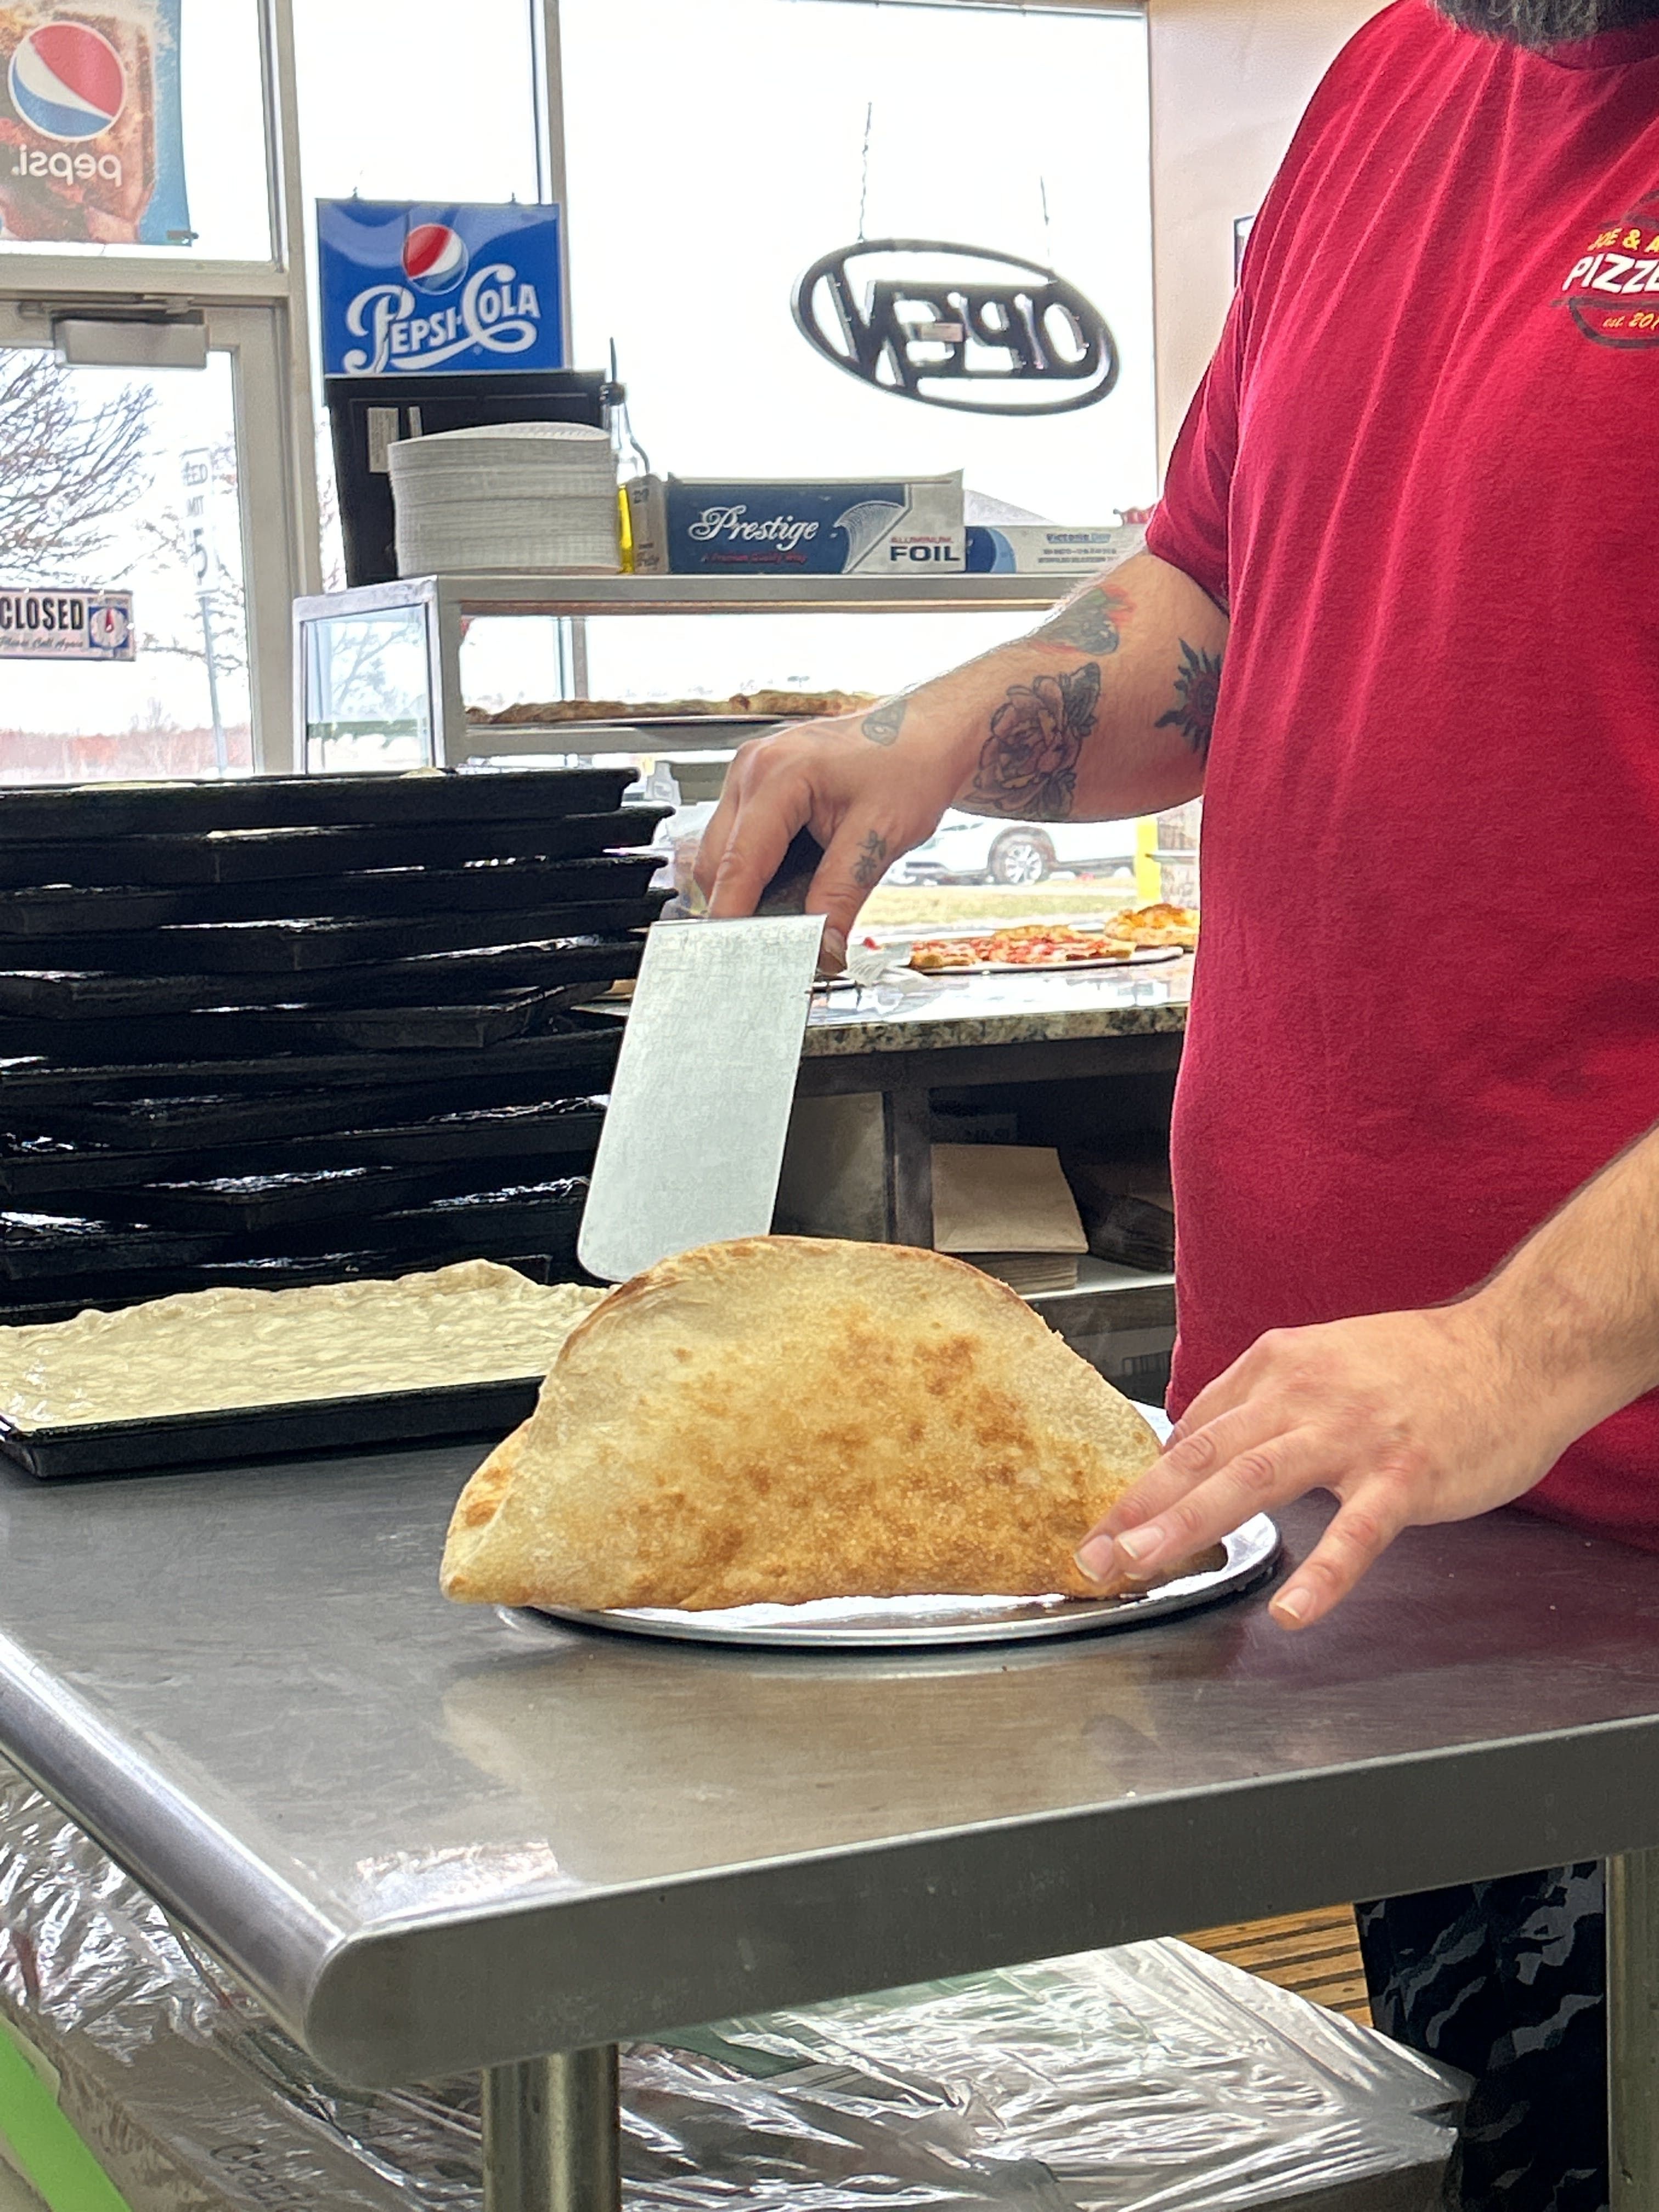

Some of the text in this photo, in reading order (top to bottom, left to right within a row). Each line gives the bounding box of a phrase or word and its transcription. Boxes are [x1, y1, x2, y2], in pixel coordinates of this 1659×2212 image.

[1622, 229, 1641, 251] &
[687, 504, 820, 551] Prestige
[890, 545, 961, 562] FOIL
[0, 597, 84, 630] CLOSED
